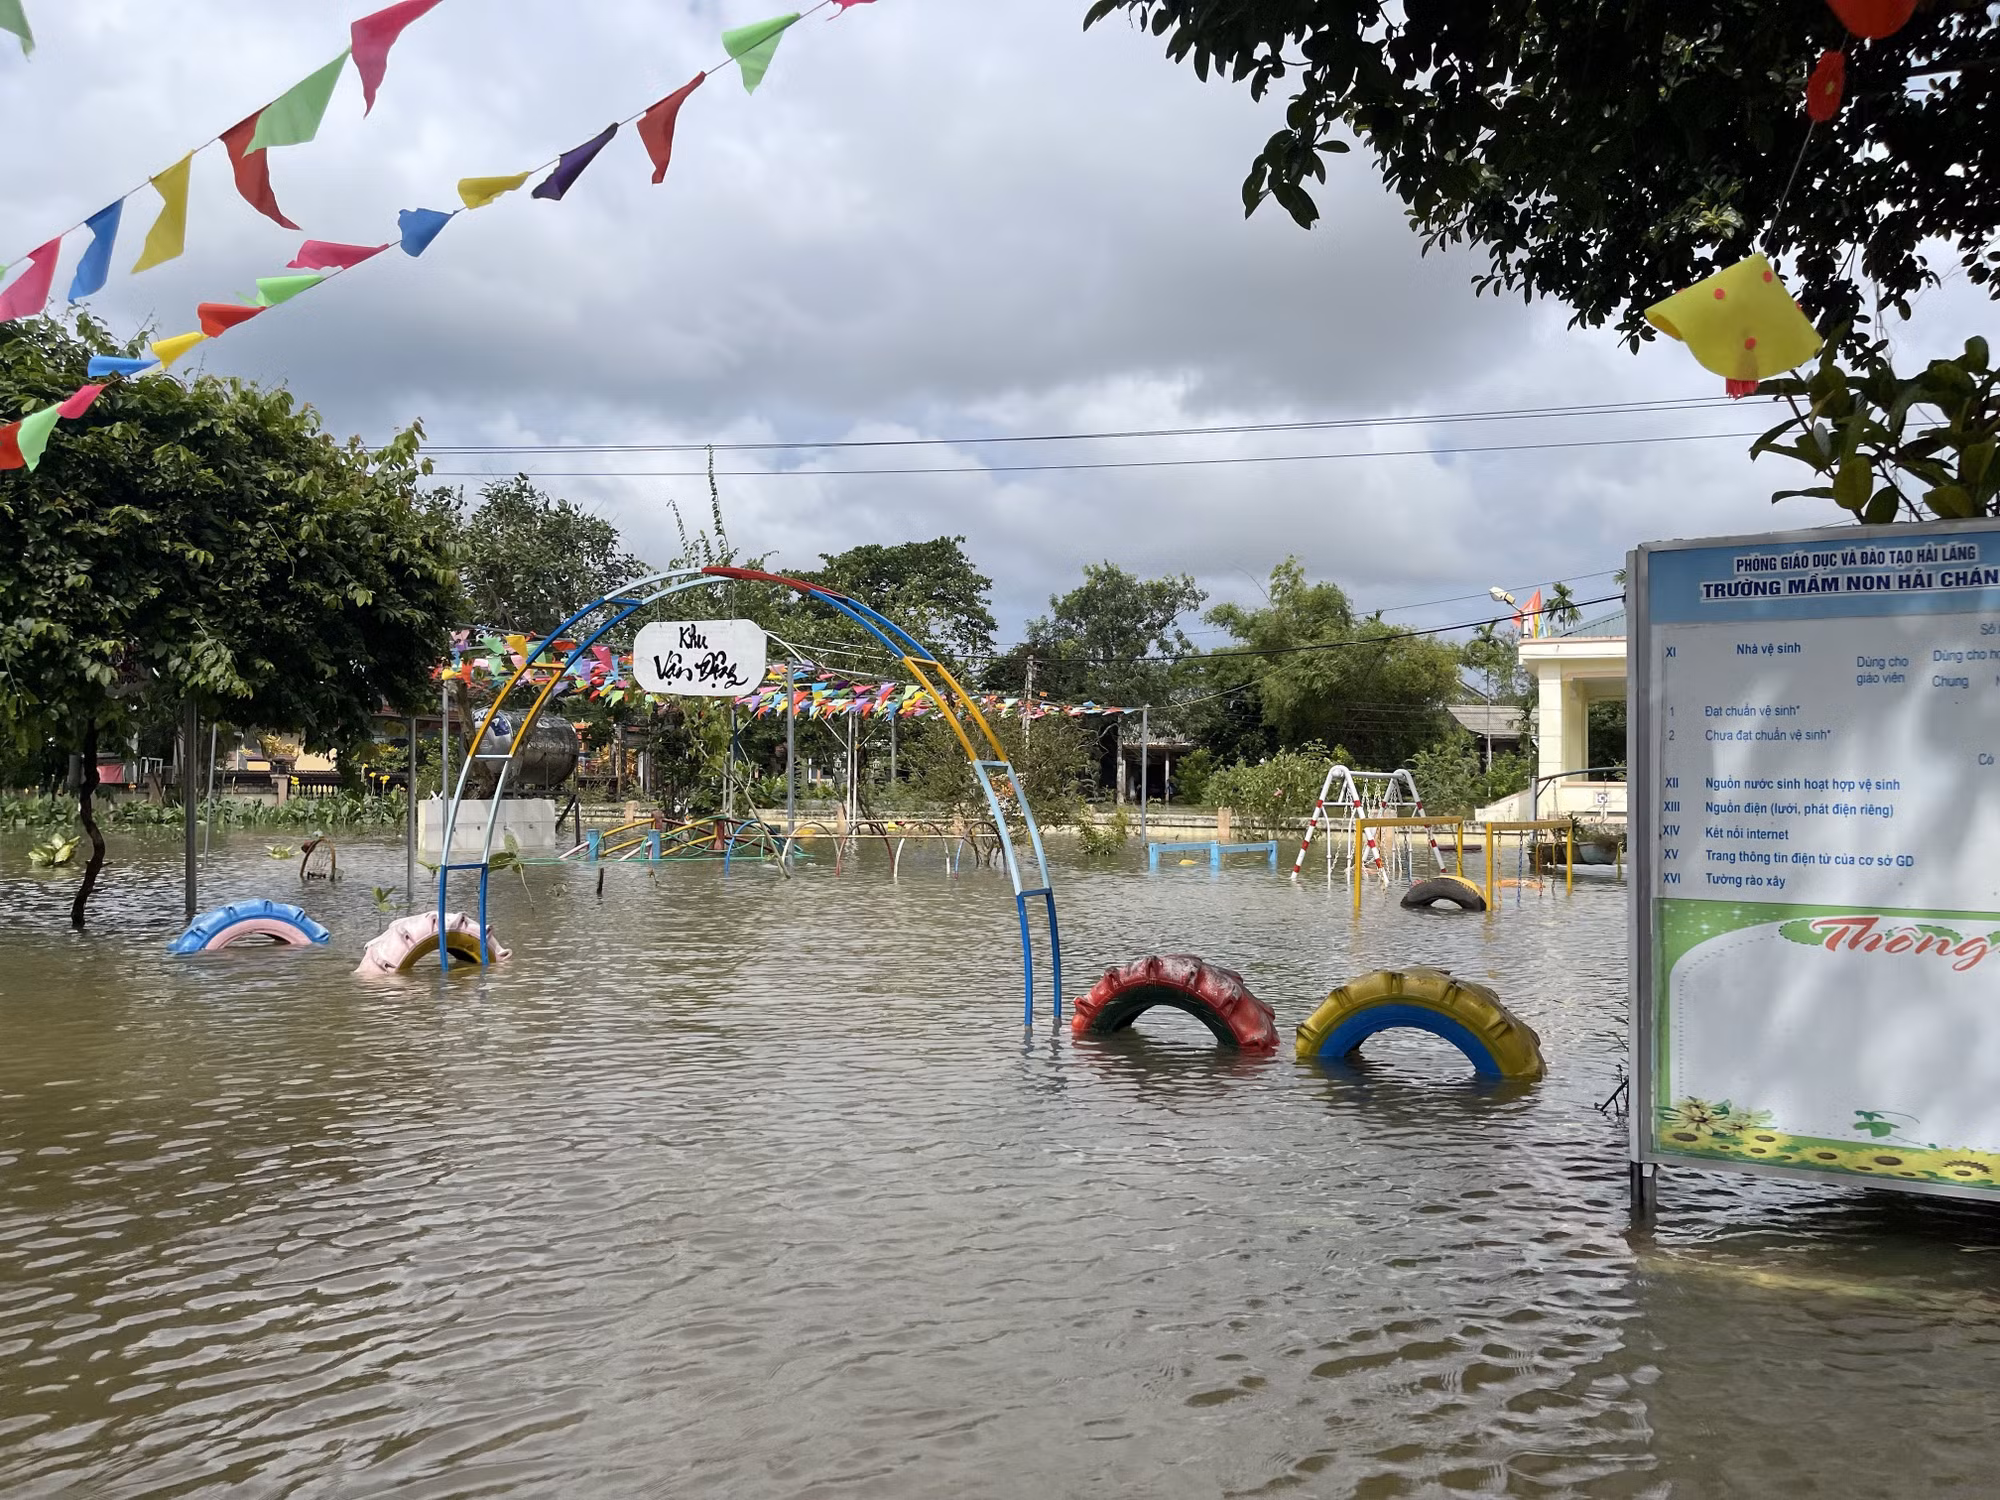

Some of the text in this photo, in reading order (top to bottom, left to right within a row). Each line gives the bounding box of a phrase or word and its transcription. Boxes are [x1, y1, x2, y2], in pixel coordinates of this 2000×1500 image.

[1736, 555, 1777, 572] PHÒNG
[1781, 553, 1809, 569] GIÁO
[1812, 553, 1837, 570] DỤC
[1841, 549, 1857, 566] VÀ
[1860, 548, 1885, 565] ĐÀO
[1889, 550, 1913, 567] TẠO
[1917, 544, 1938, 563] HẢI
[1703, 578, 1781, 598] TRƯỜNG
[1788, 573, 1839, 594] MẦM
[1846, 575, 1891, 591] NON
[1898, 569, 1932, 589] HẢI
[679, 624, 708, 649] Khu
[1666, 642, 1801, 657] XI Nhà vệ sinh
[1967, 649, 1987, 660] cho
[653, 650, 749, 689] Vận Động
[1888, 656, 1909, 667] cho
[1932, 675, 1969, 689] Chung
[1670, 706, 1674, 717] 1
[1705, 705, 1722, 718] Đạt
[1760, 706, 1772, 717] vệ
[1669, 730, 1675, 741] 2
[1705, 729, 1733, 741] Chưa
[1736, 730, 1753, 743] đạt
[1755, 726, 1787, 741] chuẩn
[1790, 729, 1802, 743] vệ
[1665, 777, 1679, 788] XII
[1744, 778, 1774, 789] nước
[1777, 778, 1800, 790] sinh
[1804, 778, 1829, 792] hoạt
[1833, 778, 1855, 792] hợp
[1859, 779, 1872, 793] vệ
[1876, 778, 1900, 790] sinh
[1663, 801, 1680, 812] XIII
[1744, 802, 1767, 816] điện
[1804, 803, 1829, 816] phát
[1832, 804, 1856, 818] điện
[1860, 804, 1894, 819] riêng)
[1663, 825, 1680, 837] XIV
[1746, 827, 1789, 840] internet
[1664, 848, 1679, 859] XV
[1706, 850, 1736, 864] Trang
[1739, 851, 1771, 865] thông
[1774, 852, 1788, 863] tin
[1791, 853, 1815, 867] điện
[1834, 853, 1855, 865] của
[1858, 856, 1874, 866] cơ
[1877, 855, 1893, 867] sở
[1896, 855, 1914, 867] GD
[1663, 873, 1786, 889] XVI Tường rào xây
[1812, 916, 1994, 971] Thông
